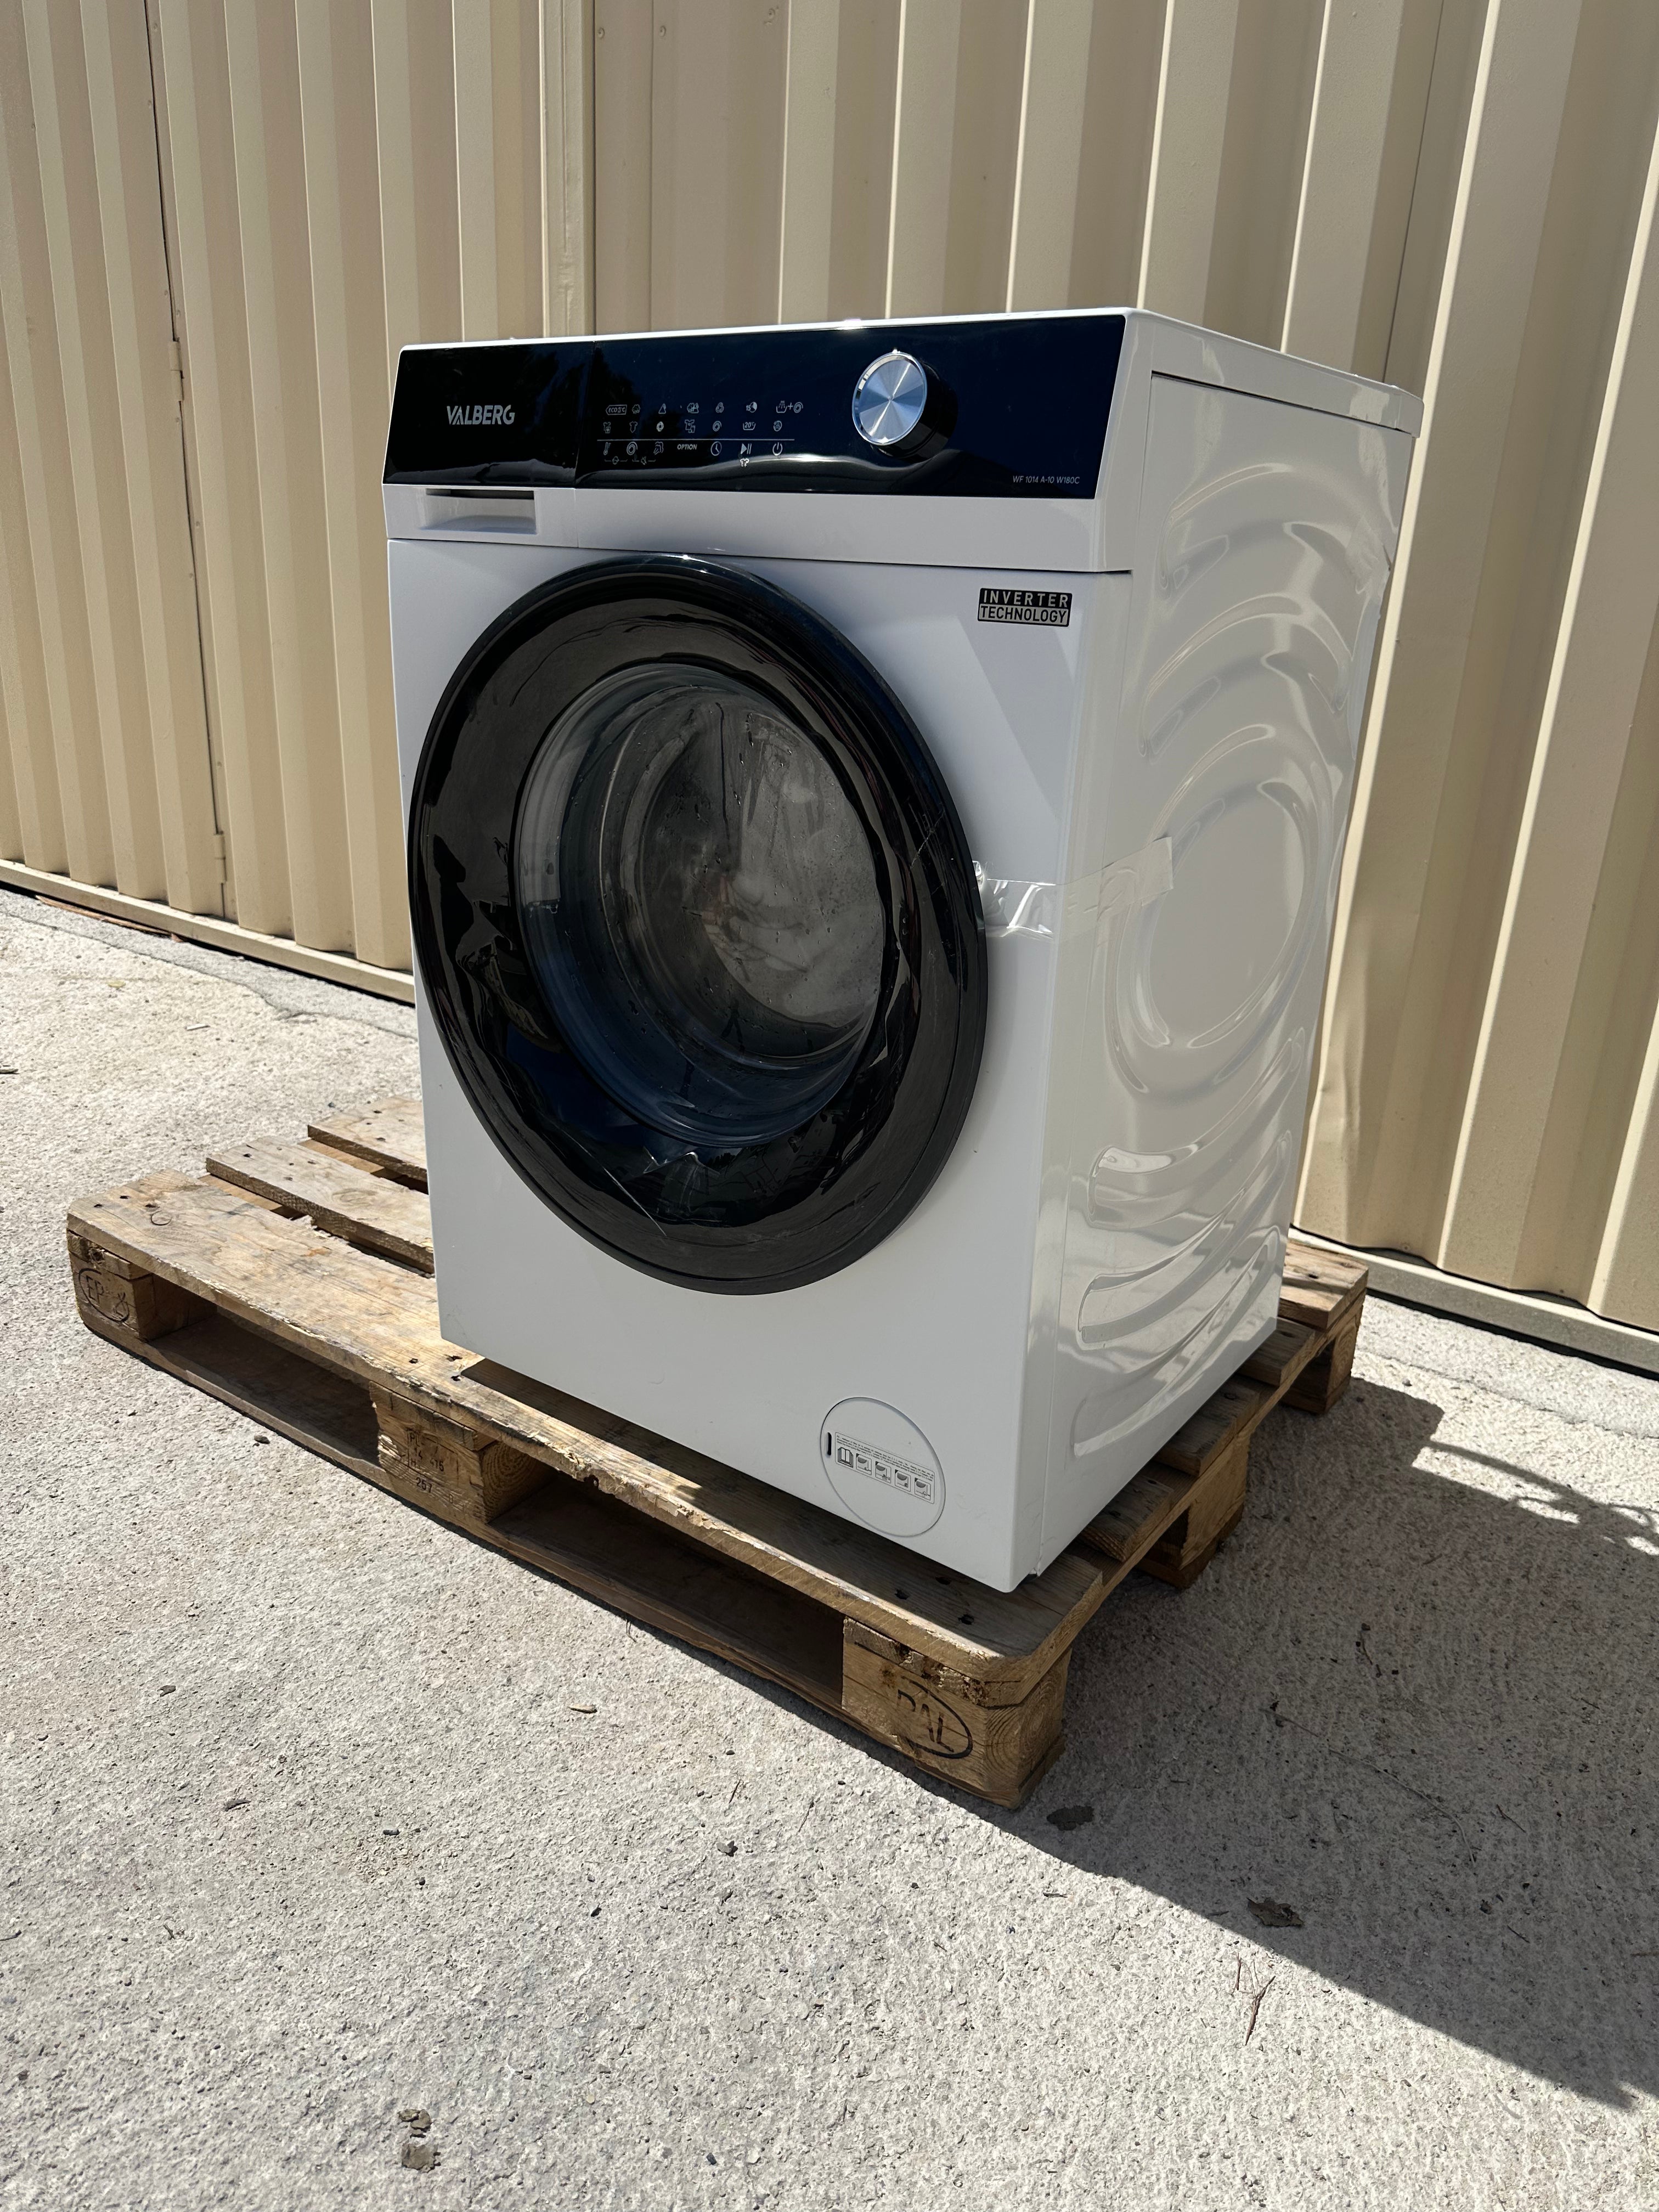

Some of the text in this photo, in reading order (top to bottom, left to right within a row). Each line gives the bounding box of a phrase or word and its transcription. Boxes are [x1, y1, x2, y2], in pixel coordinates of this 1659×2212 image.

[447, 404, 515, 425] VALBERG
[1056, 476, 1080, 484] W180C
[983, 590, 1068, 607] INVERTER
[980, 606, 1066, 623] TECHNOLOGY
[416, 1477, 432, 1493] 257
